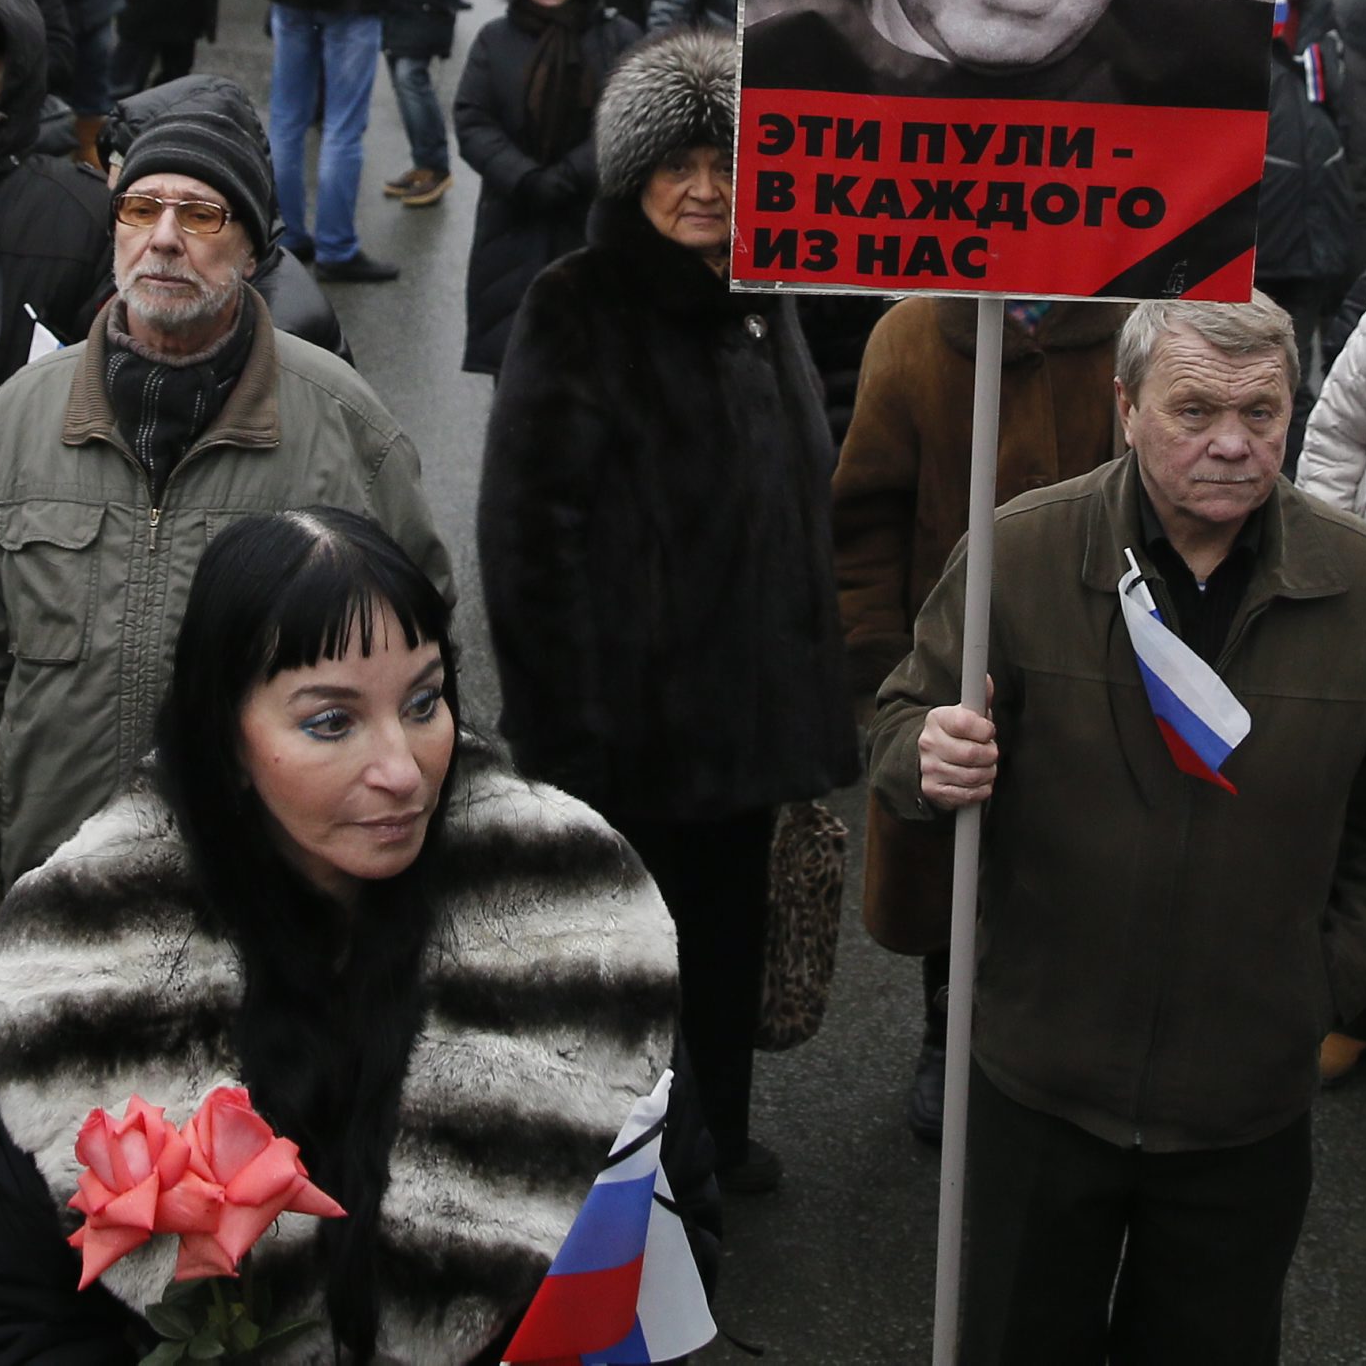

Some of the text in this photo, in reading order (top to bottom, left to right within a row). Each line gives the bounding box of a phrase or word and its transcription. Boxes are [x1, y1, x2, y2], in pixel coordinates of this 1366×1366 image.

[757, 113, 1134, 169] ЭТИ ПУЛИ -
[754, 170, 1167, 231] В КАЖДОГО
[751, 228, 989, 279] ИЗ НАС
